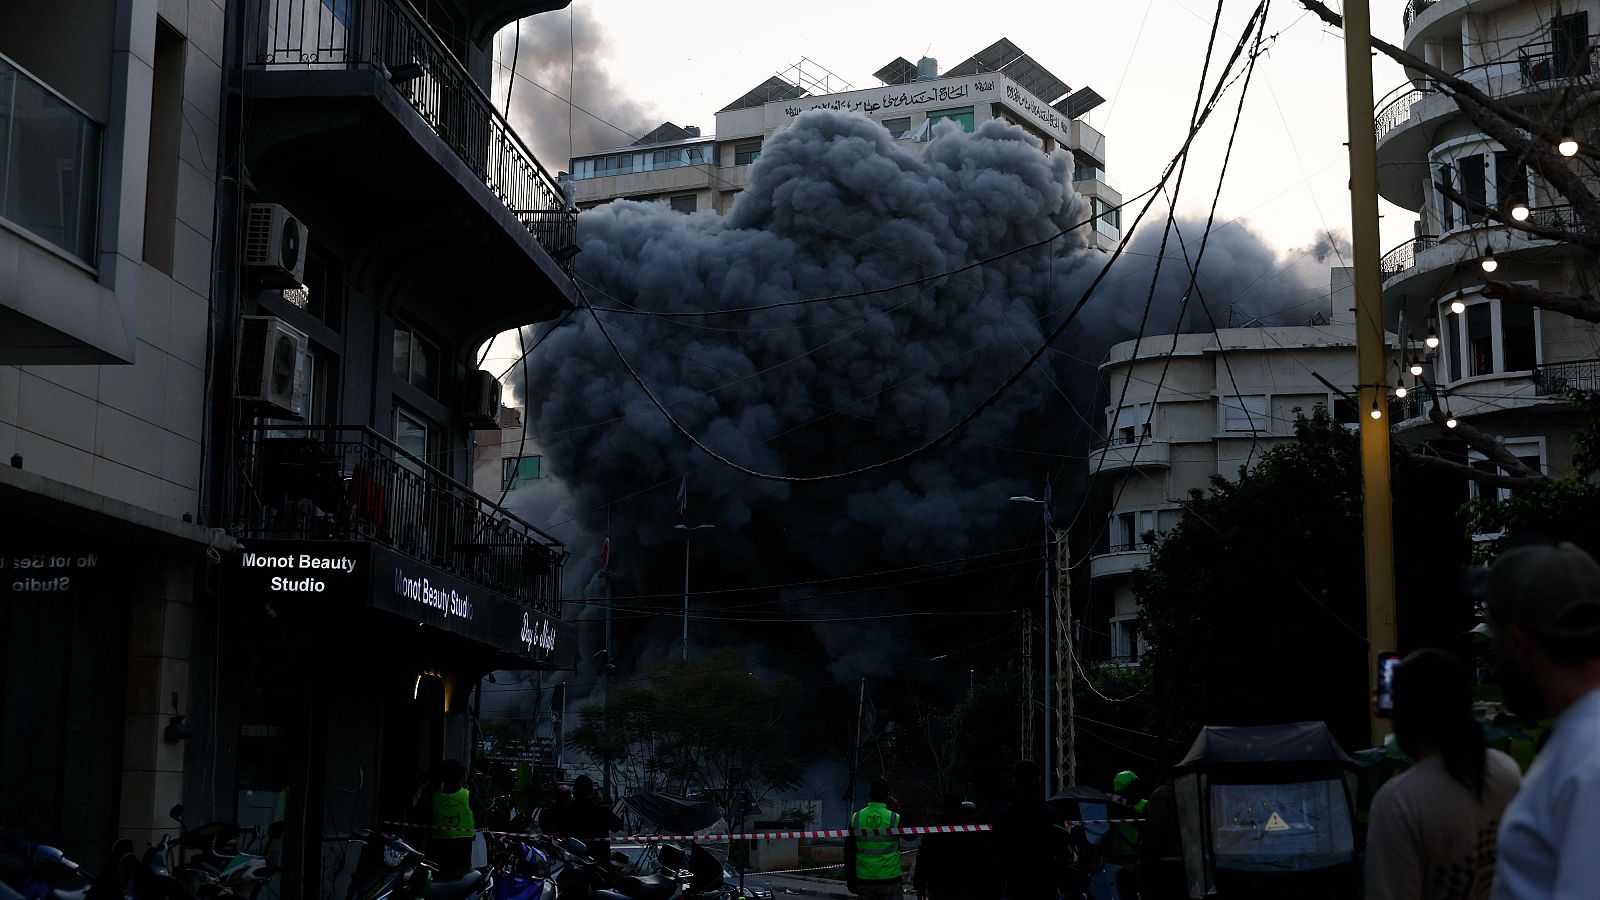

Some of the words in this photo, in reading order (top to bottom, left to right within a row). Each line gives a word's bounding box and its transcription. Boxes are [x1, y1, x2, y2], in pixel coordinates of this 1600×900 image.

[242, 552, 294, 569] Monot
[299, 553, 357, 574] Beauty
[271, 576, 325, 593] Studio
[394, 568, 421, 602] Monot
[422, 578, 450, 618] Beauty
[451, 589, 474, 621] Studio
